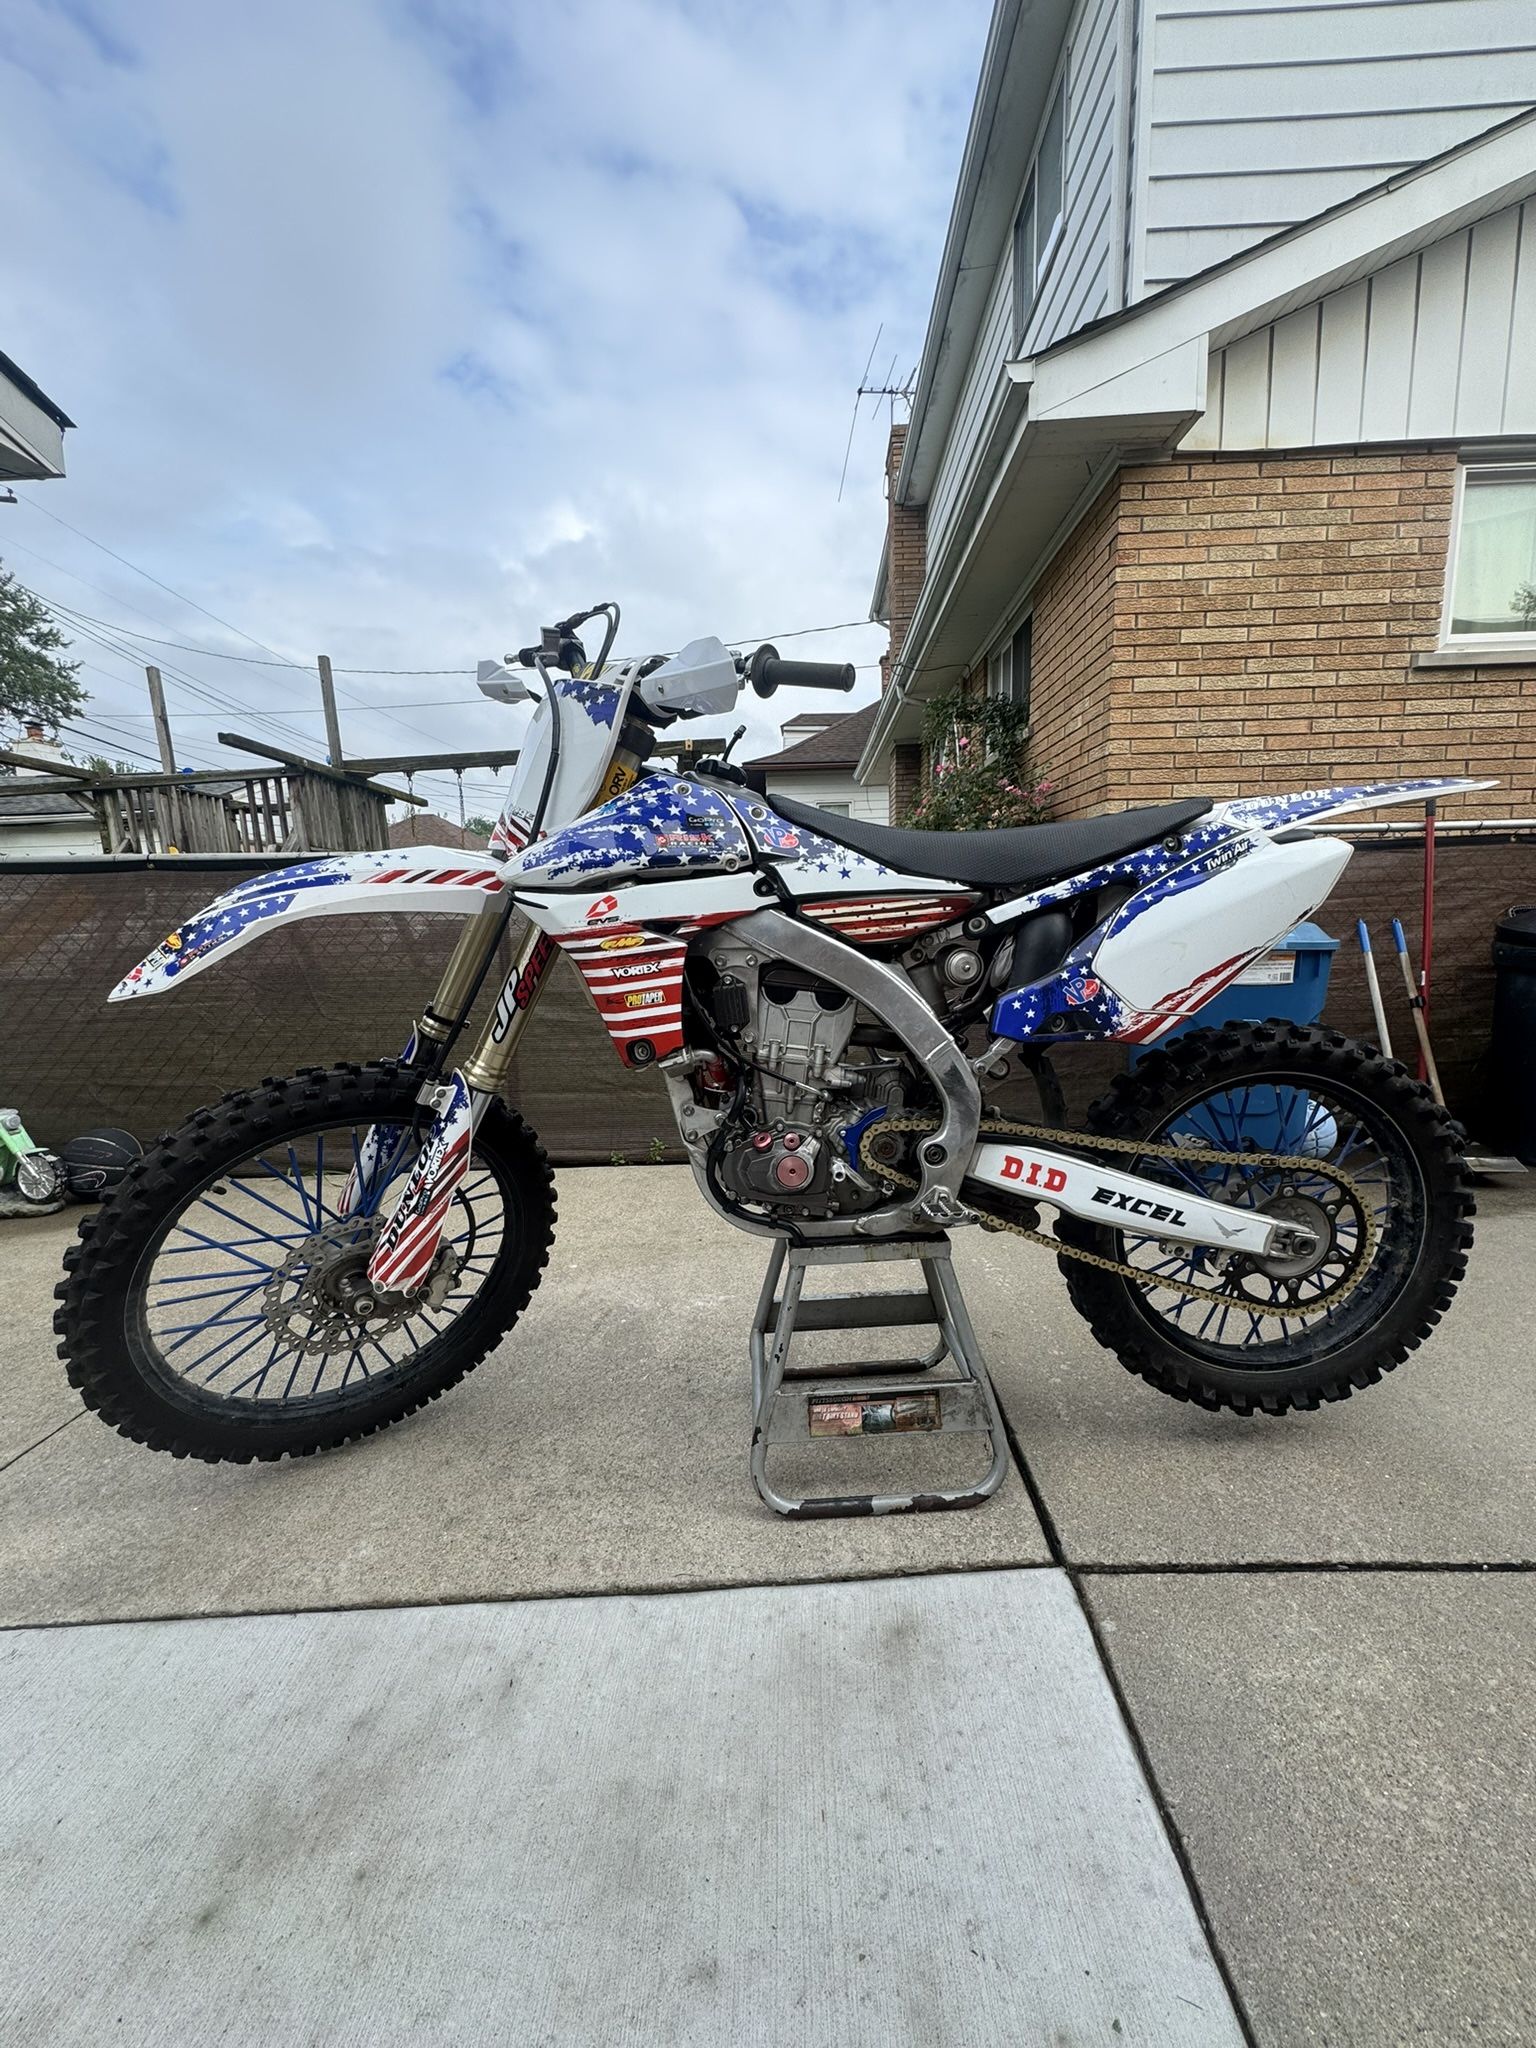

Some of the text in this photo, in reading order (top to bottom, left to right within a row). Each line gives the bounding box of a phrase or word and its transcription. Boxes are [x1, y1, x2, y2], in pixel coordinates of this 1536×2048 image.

[609, 767, 626, 795] ORV
[1204, 838, 1250, 870] Twin Air
[612, 962, 660, 979] VORTEX
[492, 966, 519, 1043] JP
[424, 1140, 448, 1187] VORTEX
[1000, 1155, 1068, 1193] D.I.D
[1091, 1186, 1187, 1227] EXCEL
